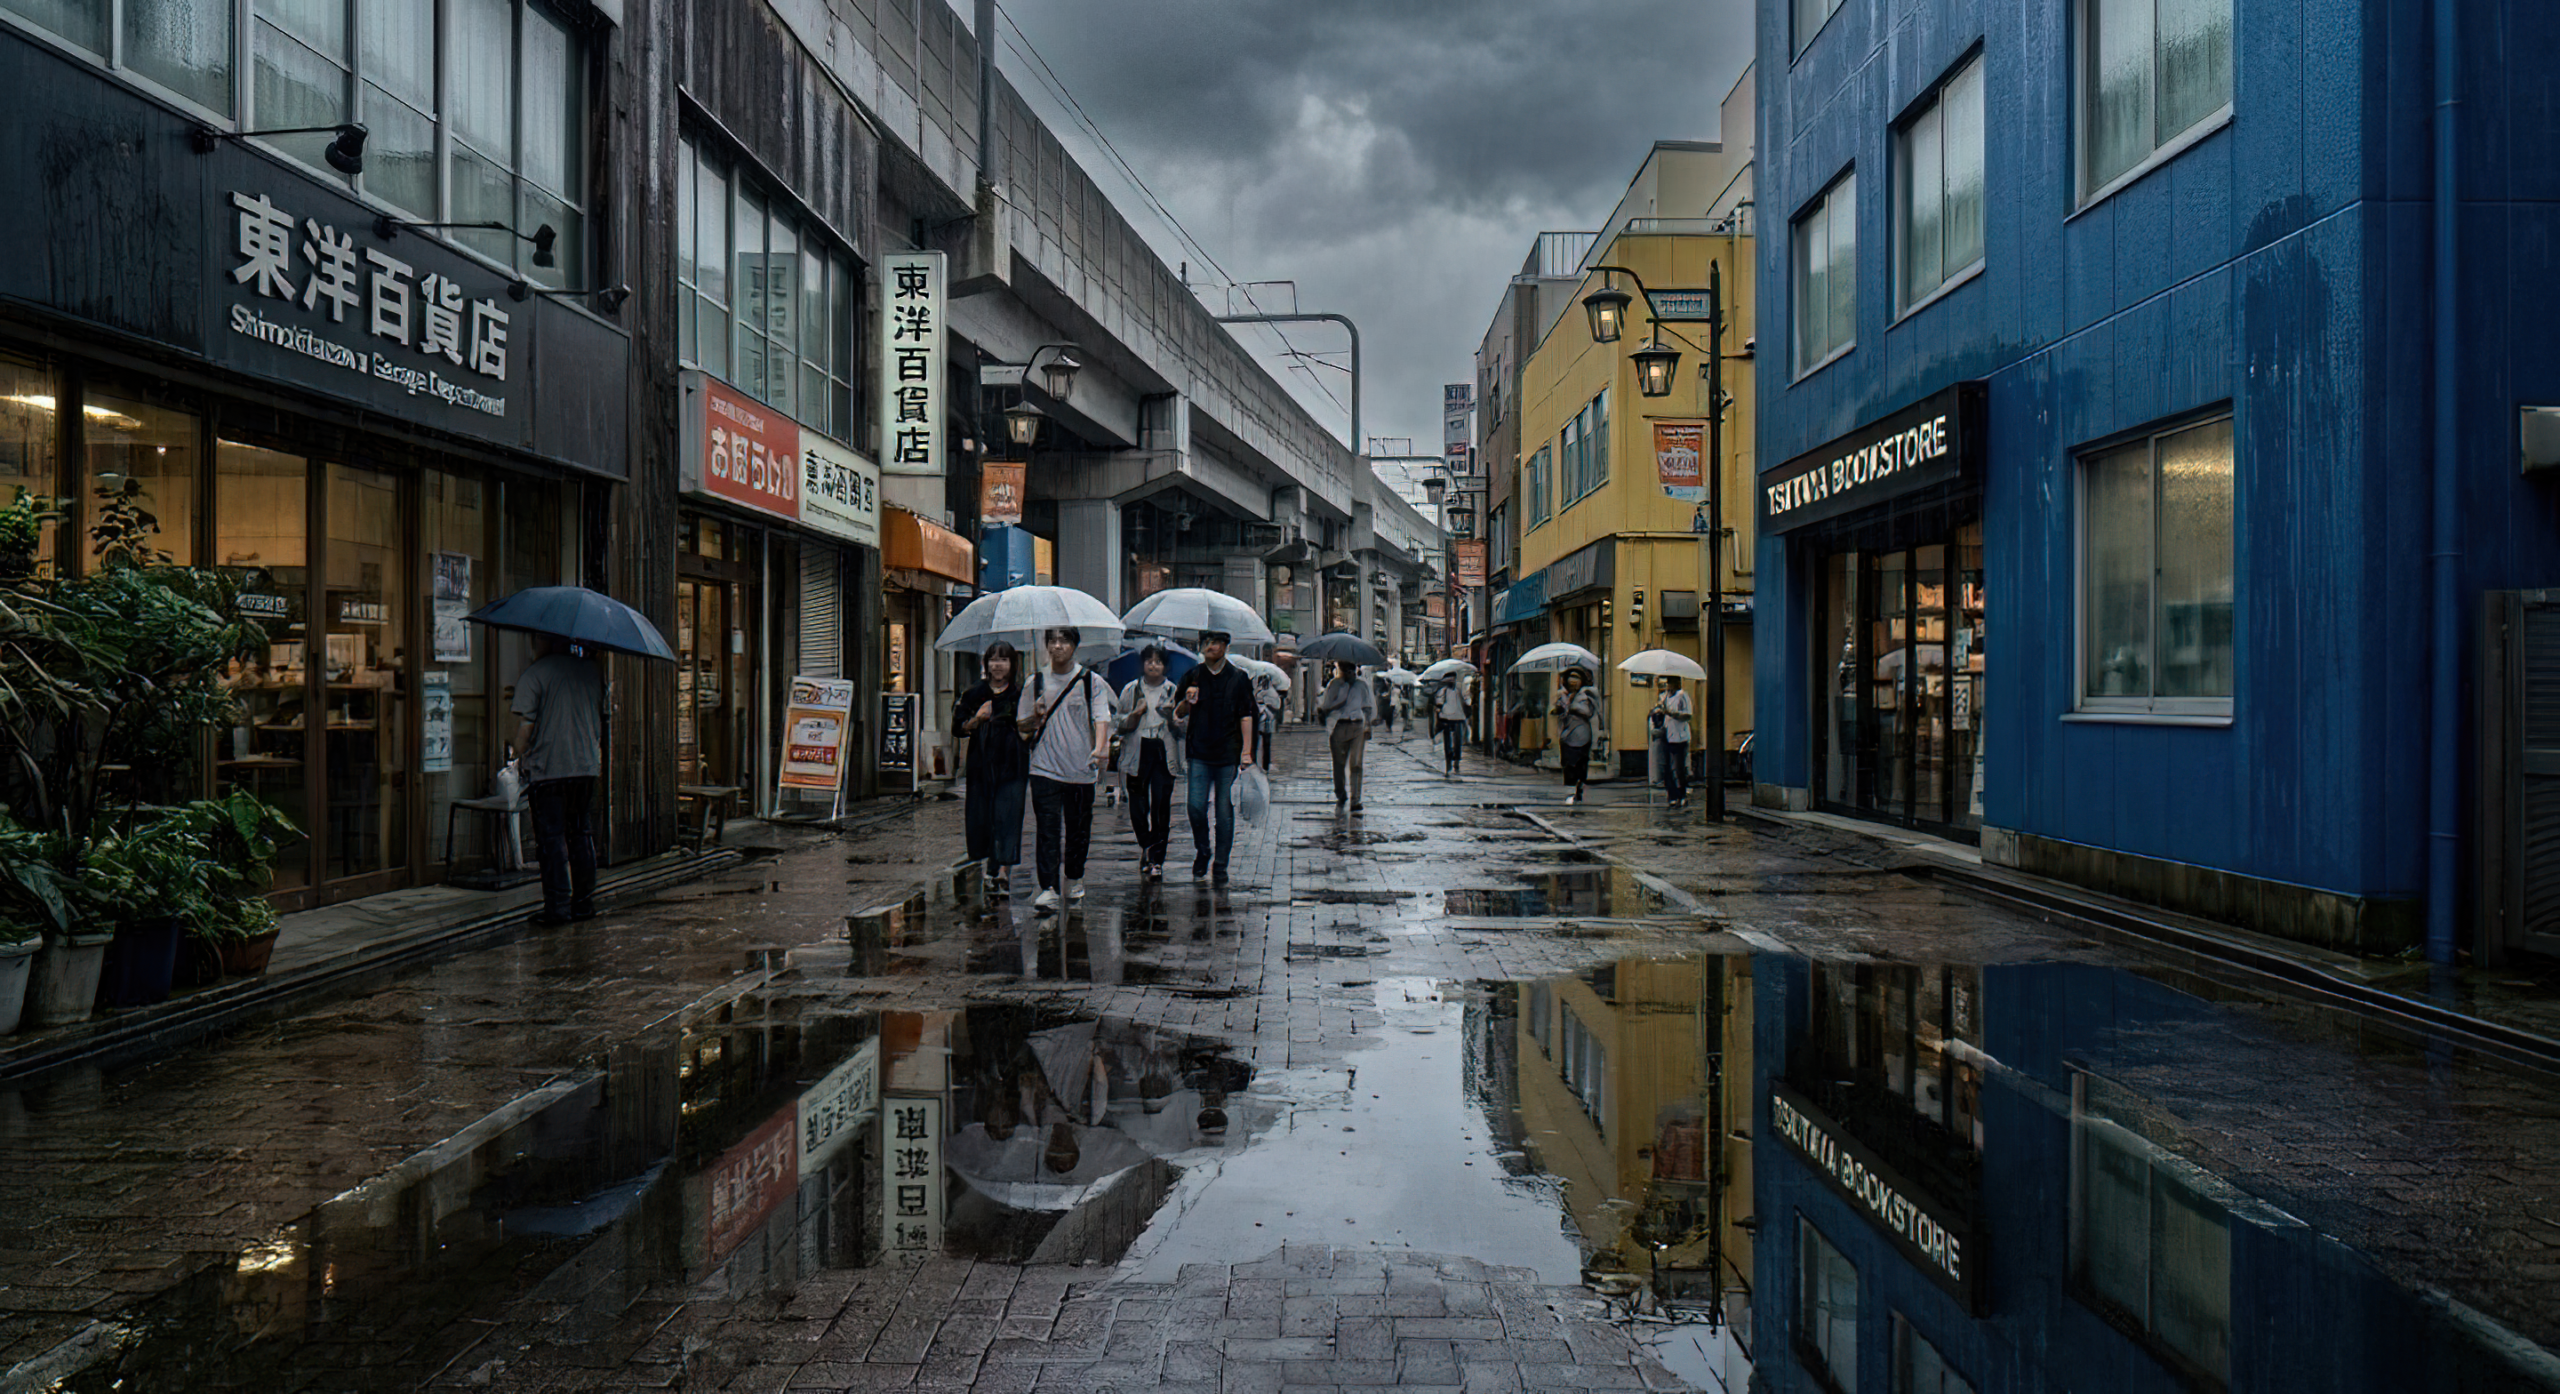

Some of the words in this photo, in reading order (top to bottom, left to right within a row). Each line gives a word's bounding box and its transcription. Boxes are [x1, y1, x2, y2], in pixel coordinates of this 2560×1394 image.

[229, 191, 510, 381] 東洋百貨店
[892, 261, 932, 463] 東洋百貨店
